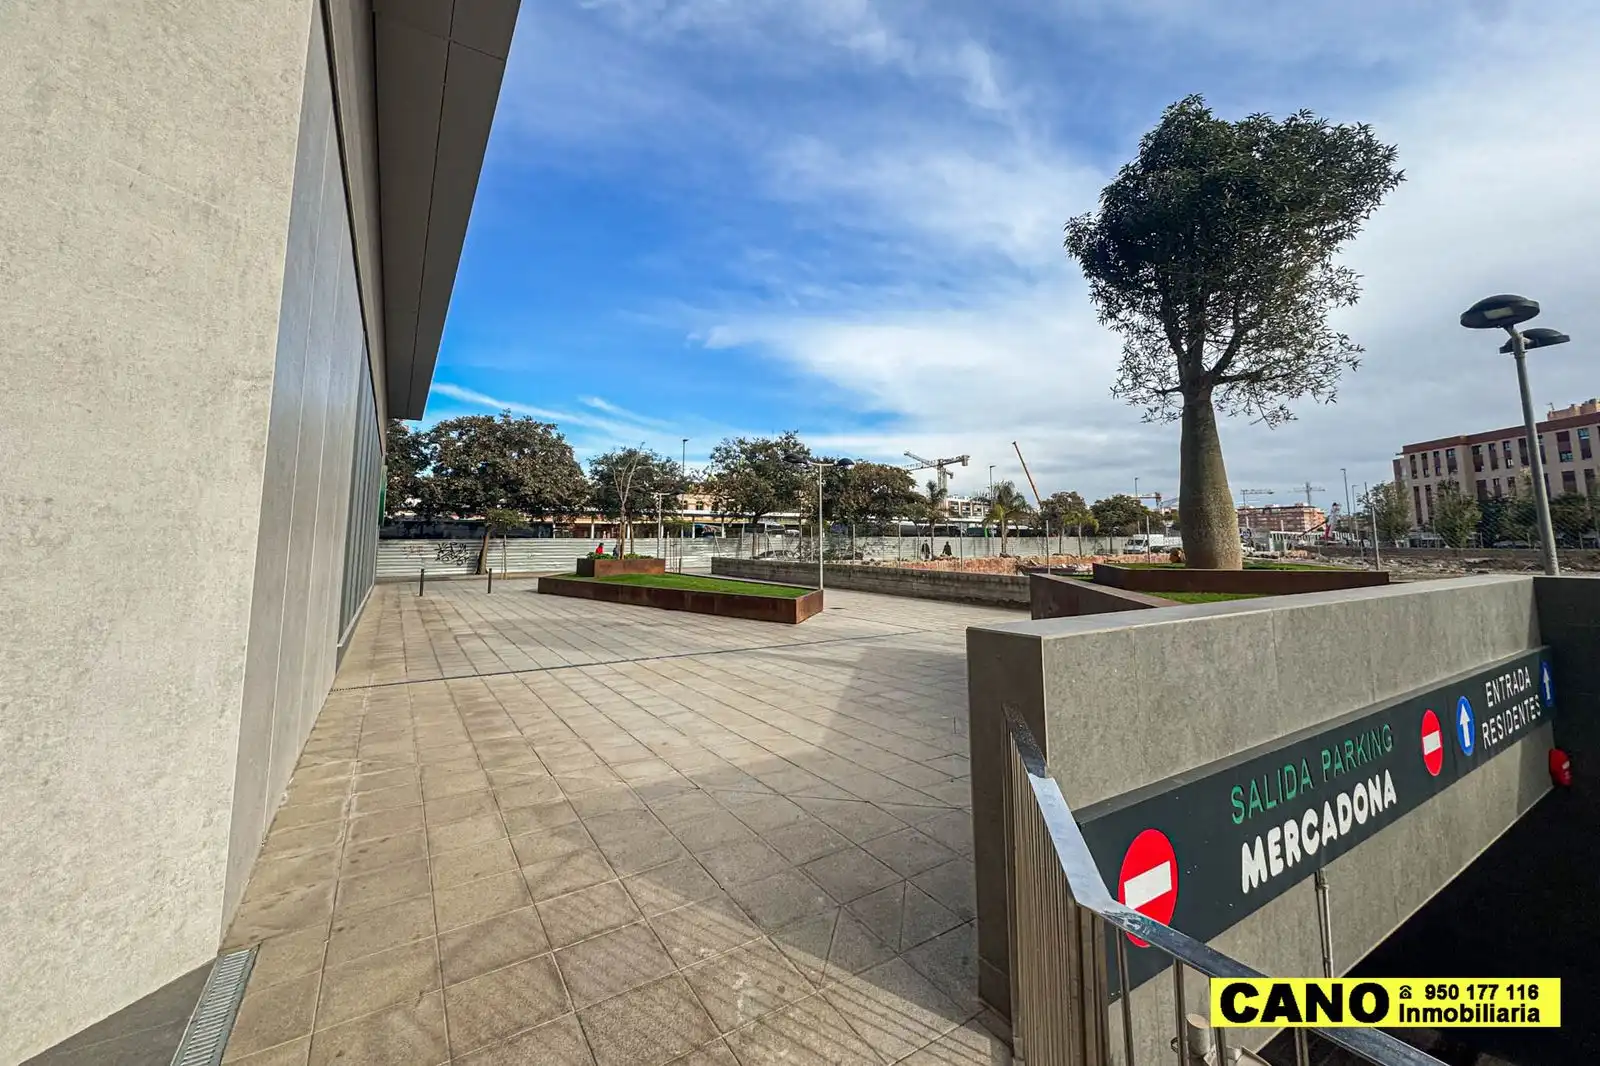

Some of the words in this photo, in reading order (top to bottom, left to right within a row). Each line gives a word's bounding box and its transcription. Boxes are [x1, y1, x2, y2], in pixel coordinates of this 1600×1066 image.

[1482, 694, 1542, 750] RESIDENTES
[1485, 665, 1532, 708] ENTRADA
[1231, 762, 1313, 825] SALIDA
[1321, 723, 1395, 782] PARKING
[1241, 768, 1398, 894] MERCADONA
